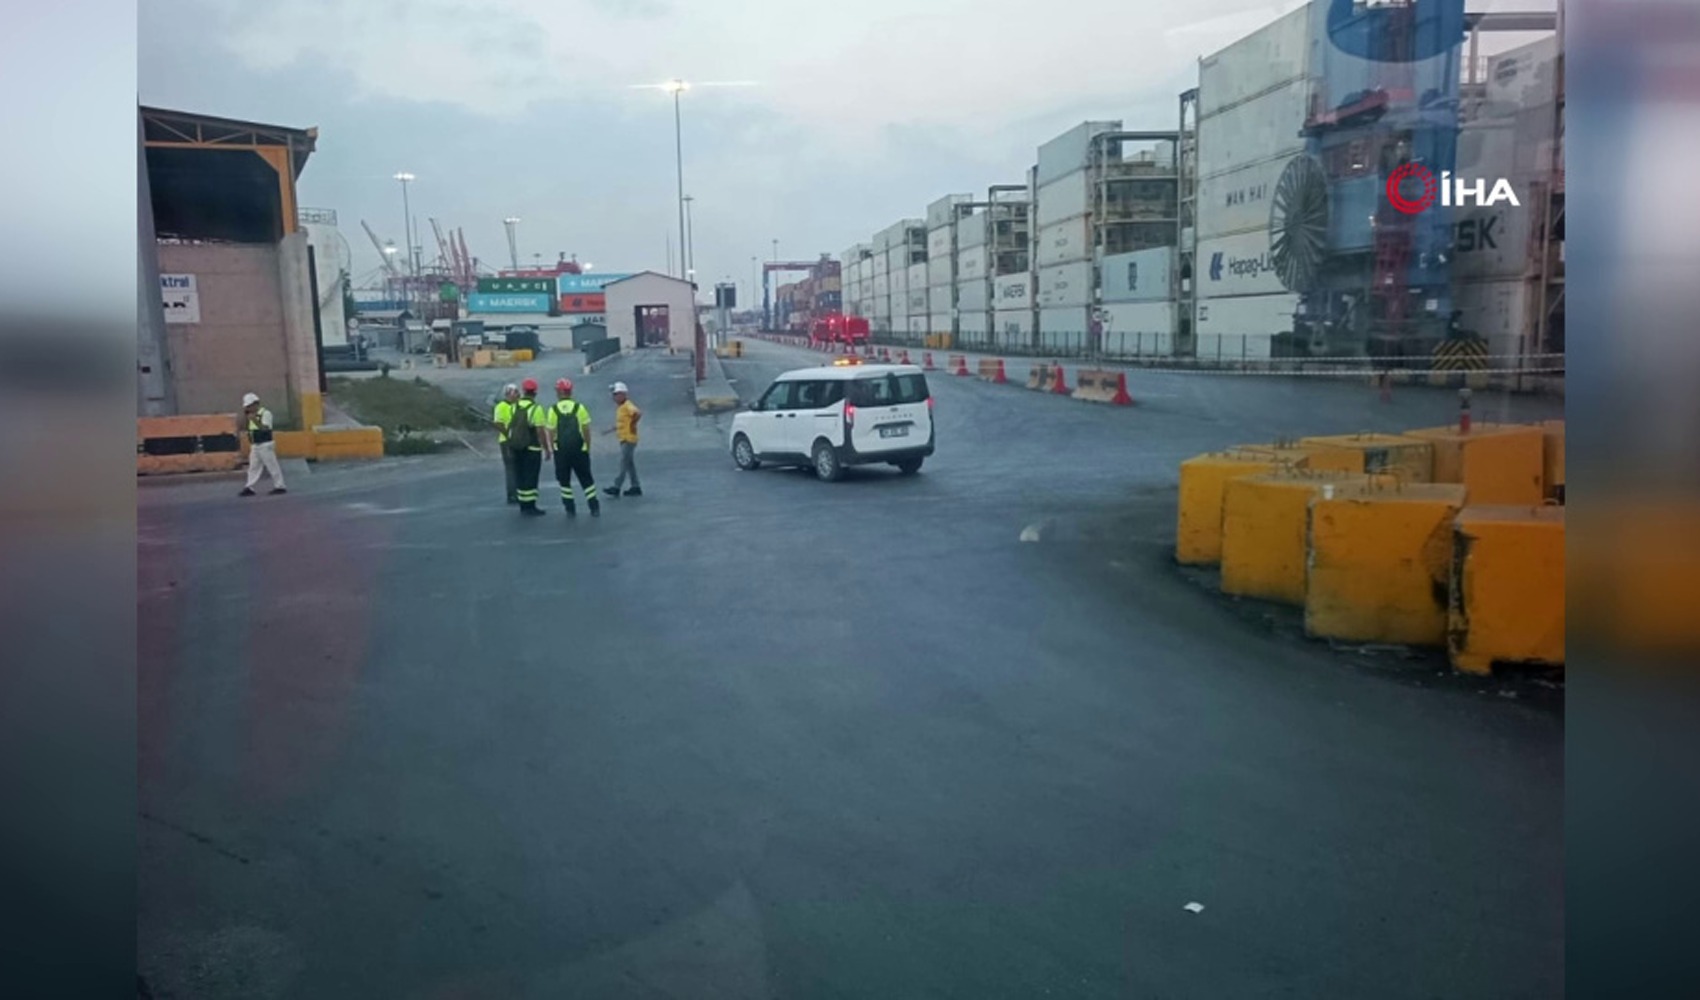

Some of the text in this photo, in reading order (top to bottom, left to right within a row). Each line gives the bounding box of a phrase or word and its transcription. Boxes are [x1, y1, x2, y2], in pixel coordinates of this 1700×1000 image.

[1451, 215, 1498, 252] SK
[1228, 252, 1276, 279] Hapag-Llo
[489, 297, 538, 307] MAERSK
